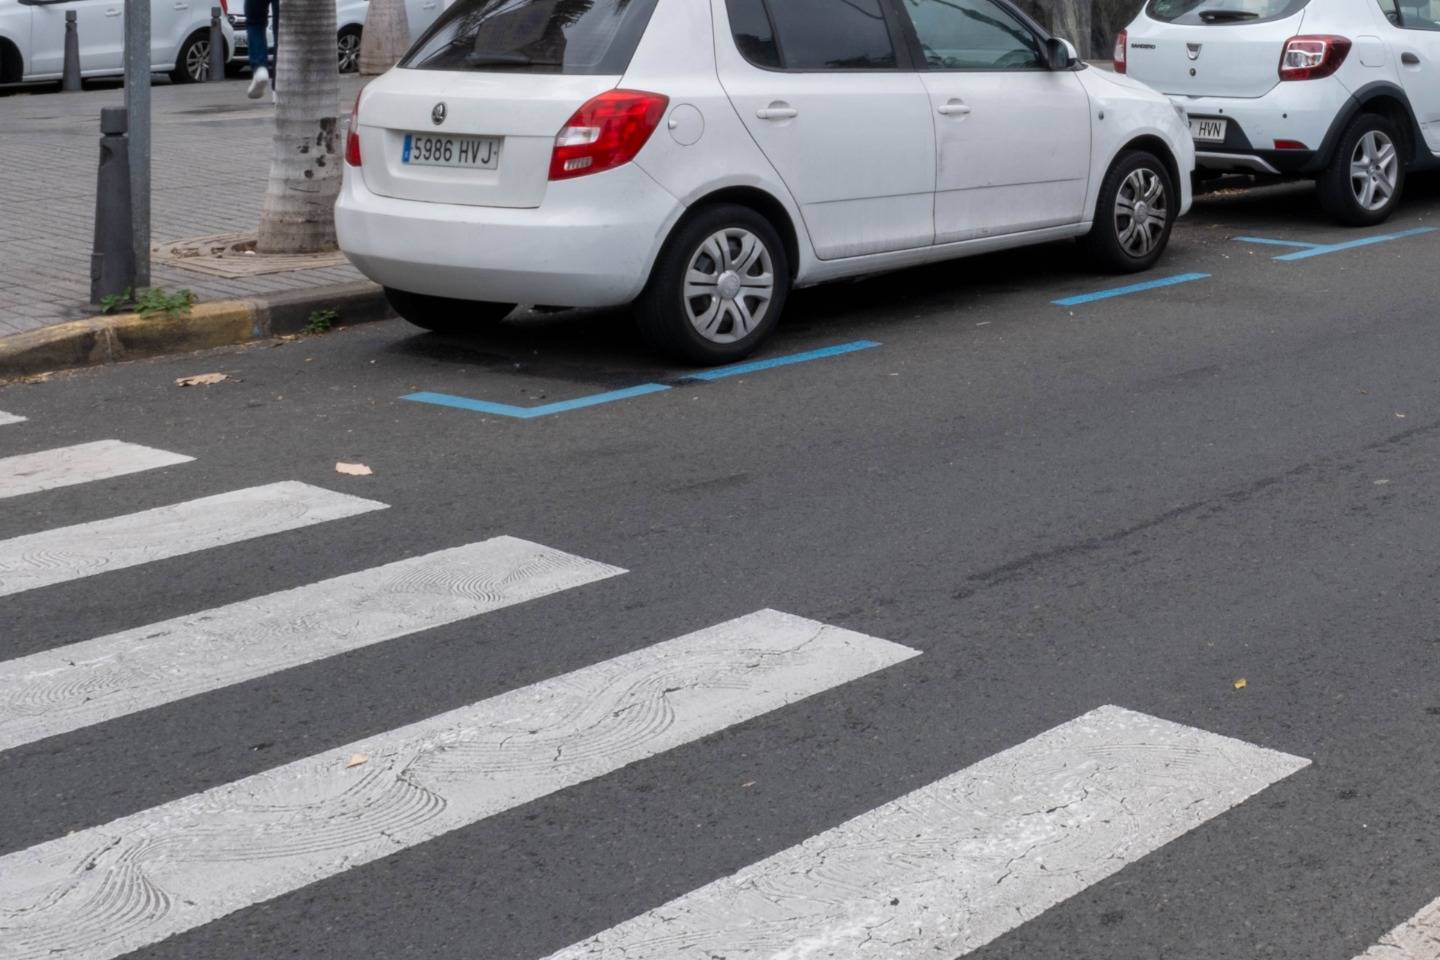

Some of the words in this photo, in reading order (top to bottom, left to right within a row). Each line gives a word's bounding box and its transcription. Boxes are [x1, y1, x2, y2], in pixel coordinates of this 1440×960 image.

[1199, 121, 1221, 137] HVN
[414, 138, 453, 162] 5986
[459, 140, 493, 165] HVJ
